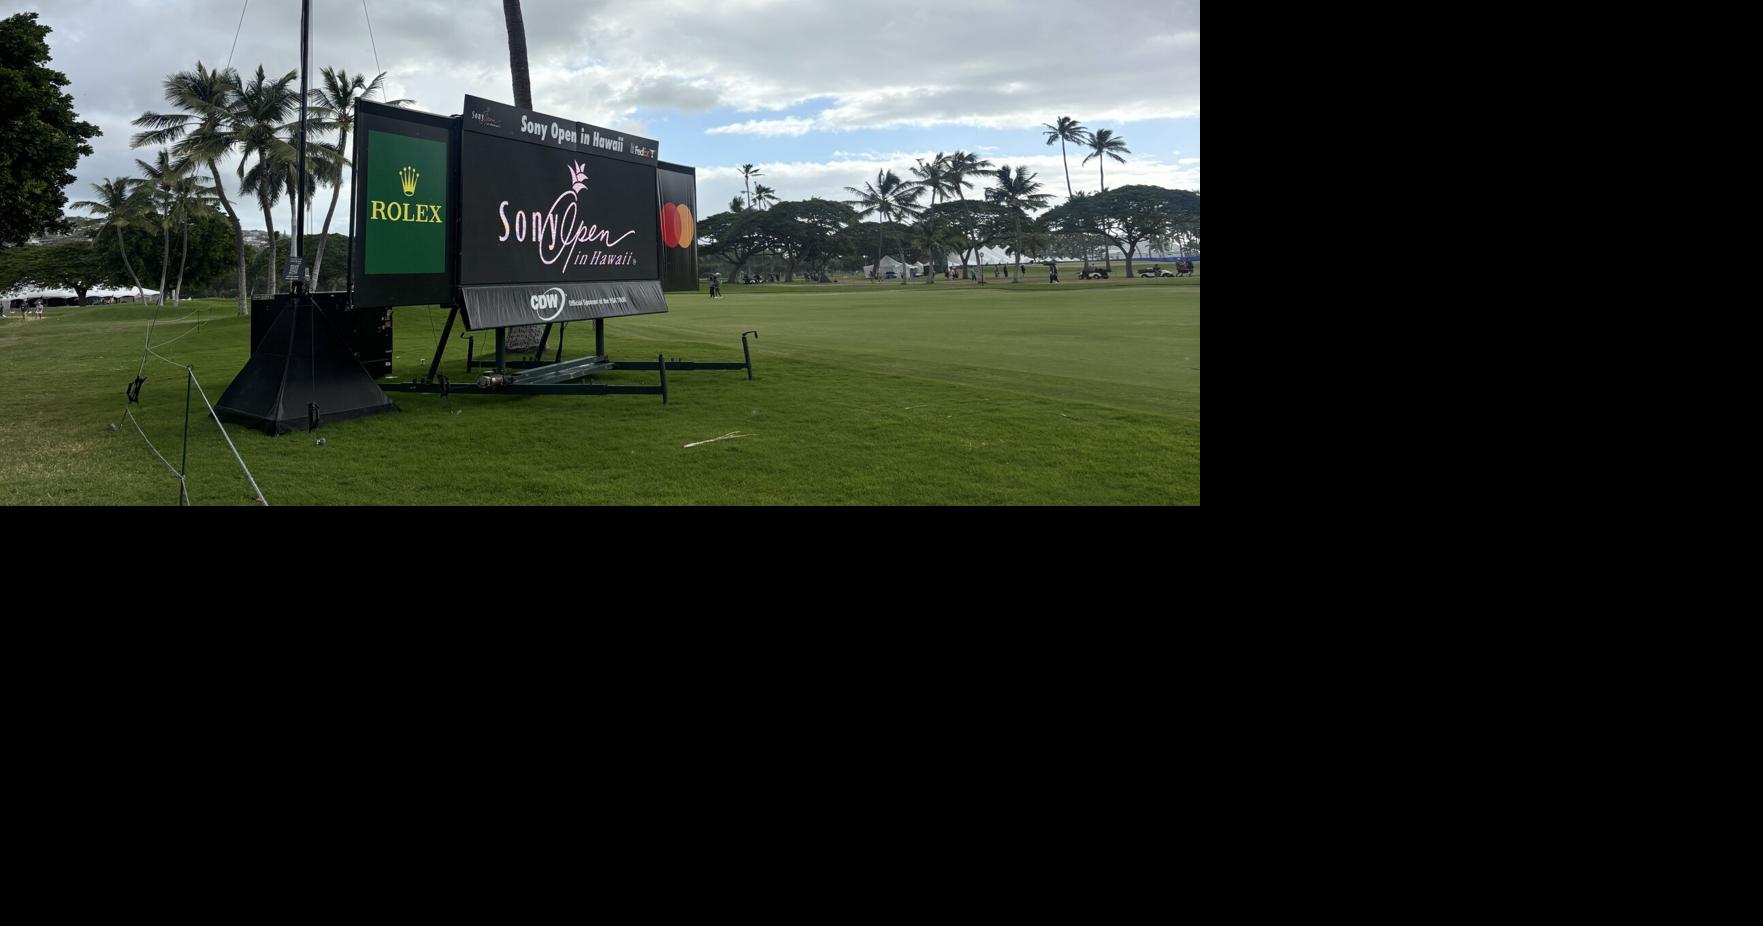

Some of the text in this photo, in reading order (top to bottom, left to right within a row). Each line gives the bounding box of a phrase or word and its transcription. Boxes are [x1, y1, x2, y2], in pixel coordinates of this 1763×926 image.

[520, 115, 548, 141] Sony
[551, 121, 577, 145] Open
[580, 128, 590, 145] in
[593, 131, 624, 153] Hawaii
[370, 200, 443, 224] ROLEX
[499, 190, 636, 274] Sony Open
[574, 251, 633, 265] in Hawaii
[530, 293, 559, 311] CDW
